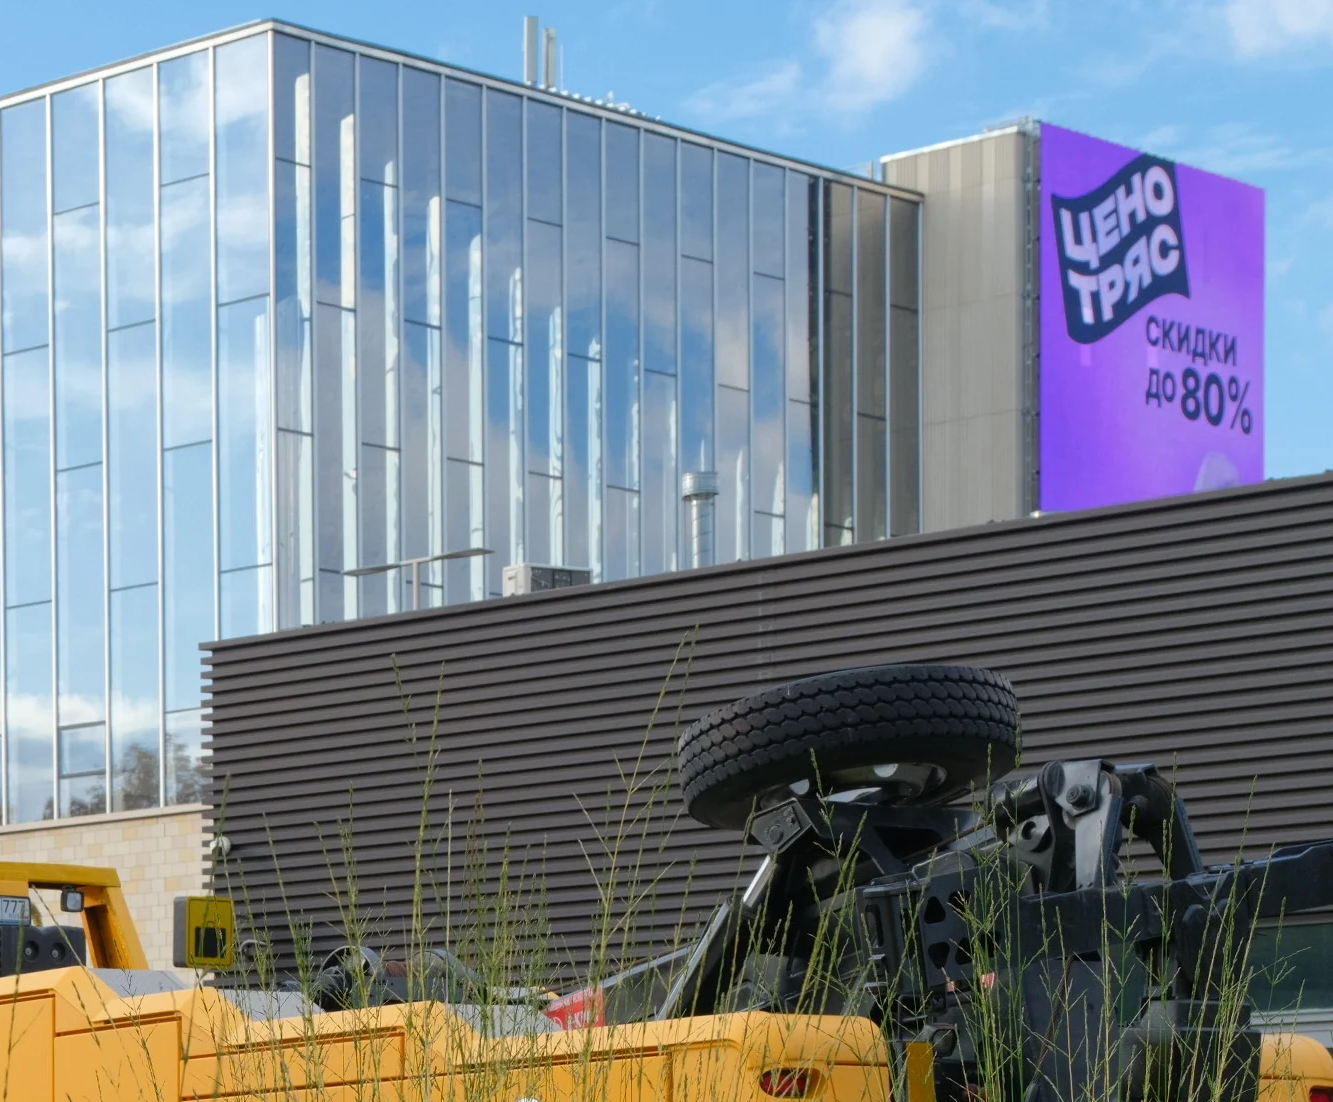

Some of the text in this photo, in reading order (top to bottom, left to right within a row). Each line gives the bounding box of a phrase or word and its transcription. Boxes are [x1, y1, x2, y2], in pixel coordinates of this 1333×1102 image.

[1059, 165, 1175, 271] ЦЕНО
[1066, 223, 1181, 325] ТРЯС
[1180, 366, 1252, 435] 80%
